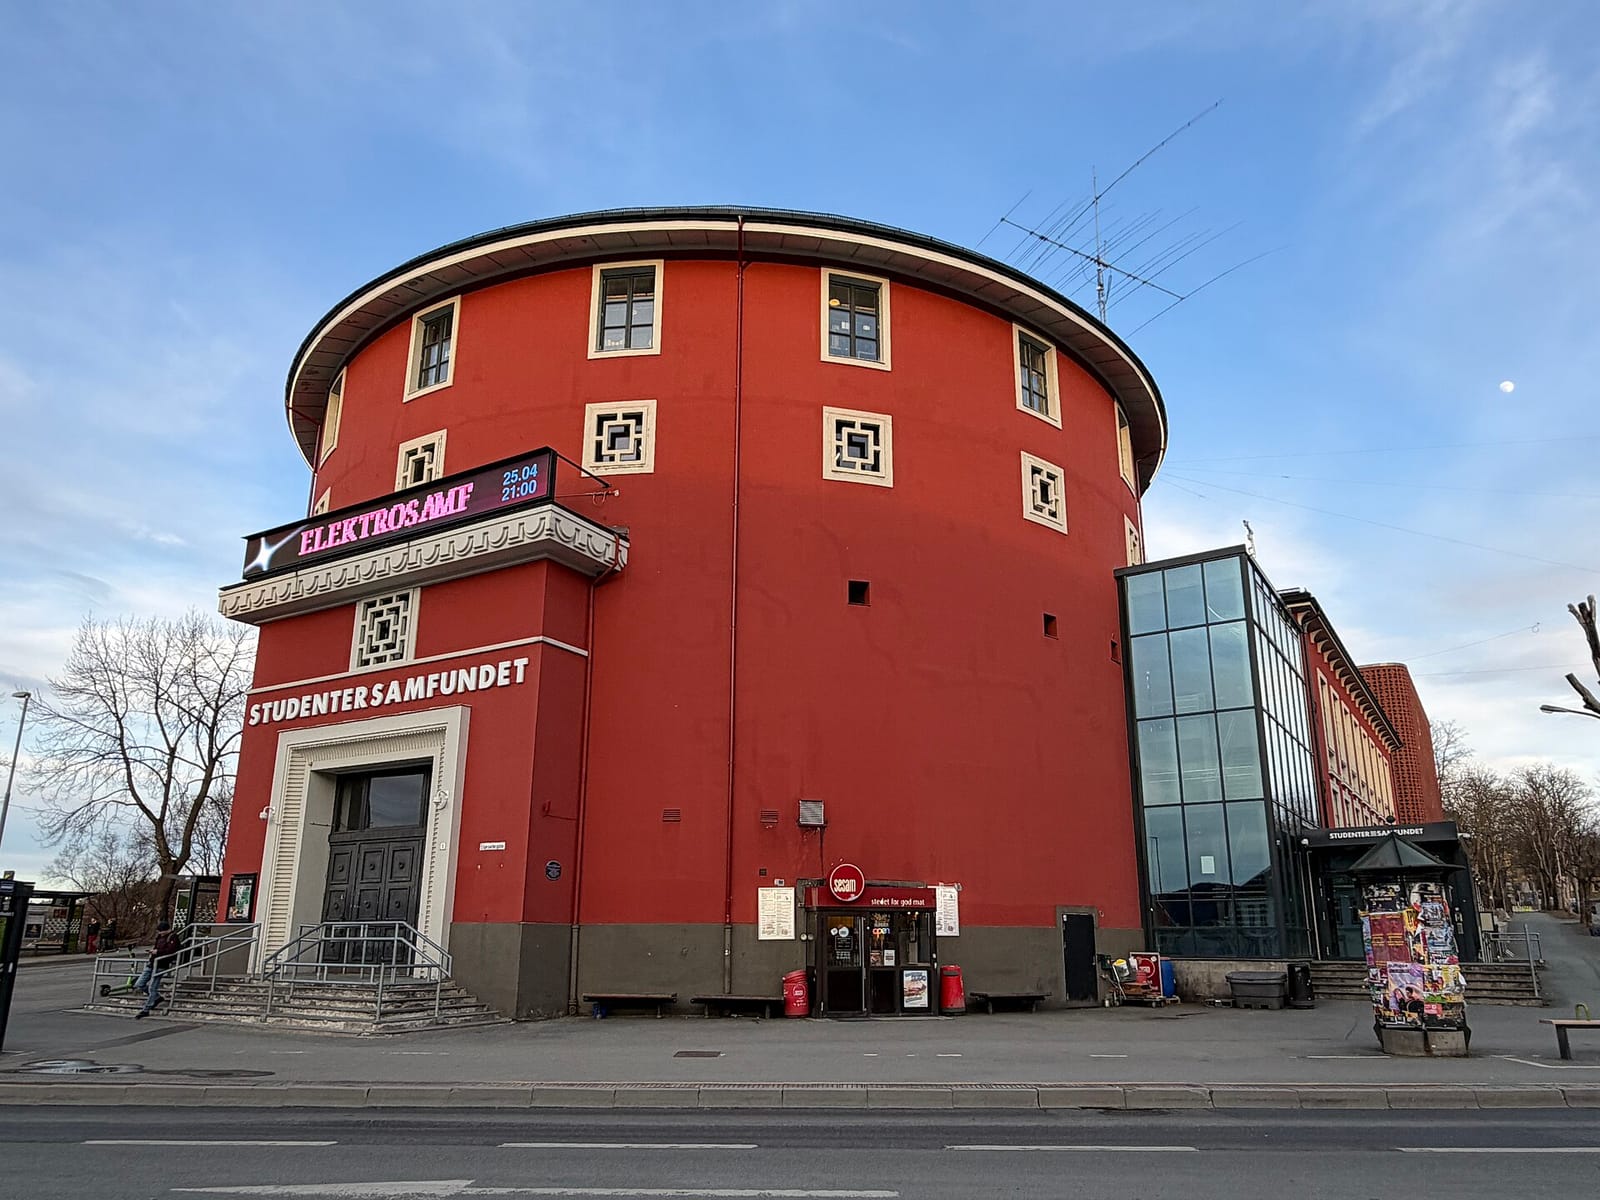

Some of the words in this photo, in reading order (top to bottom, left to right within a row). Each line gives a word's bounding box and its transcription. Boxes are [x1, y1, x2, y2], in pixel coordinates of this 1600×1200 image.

[502, 463, 538, 487] 25.04
[501, 479, 538, 502] 21:00
[298, 482, 475, 557] ELEKTROSAMF
[248, 657, 530, 726] STUDENTERSAMFUNDET
[833, 879, 856, 892] sesam
[890, 898, 899, 906] for
[900, 898, 912, 907] god
[912, 898, 925, 906] mat
[872, 928, 890, 938] open
